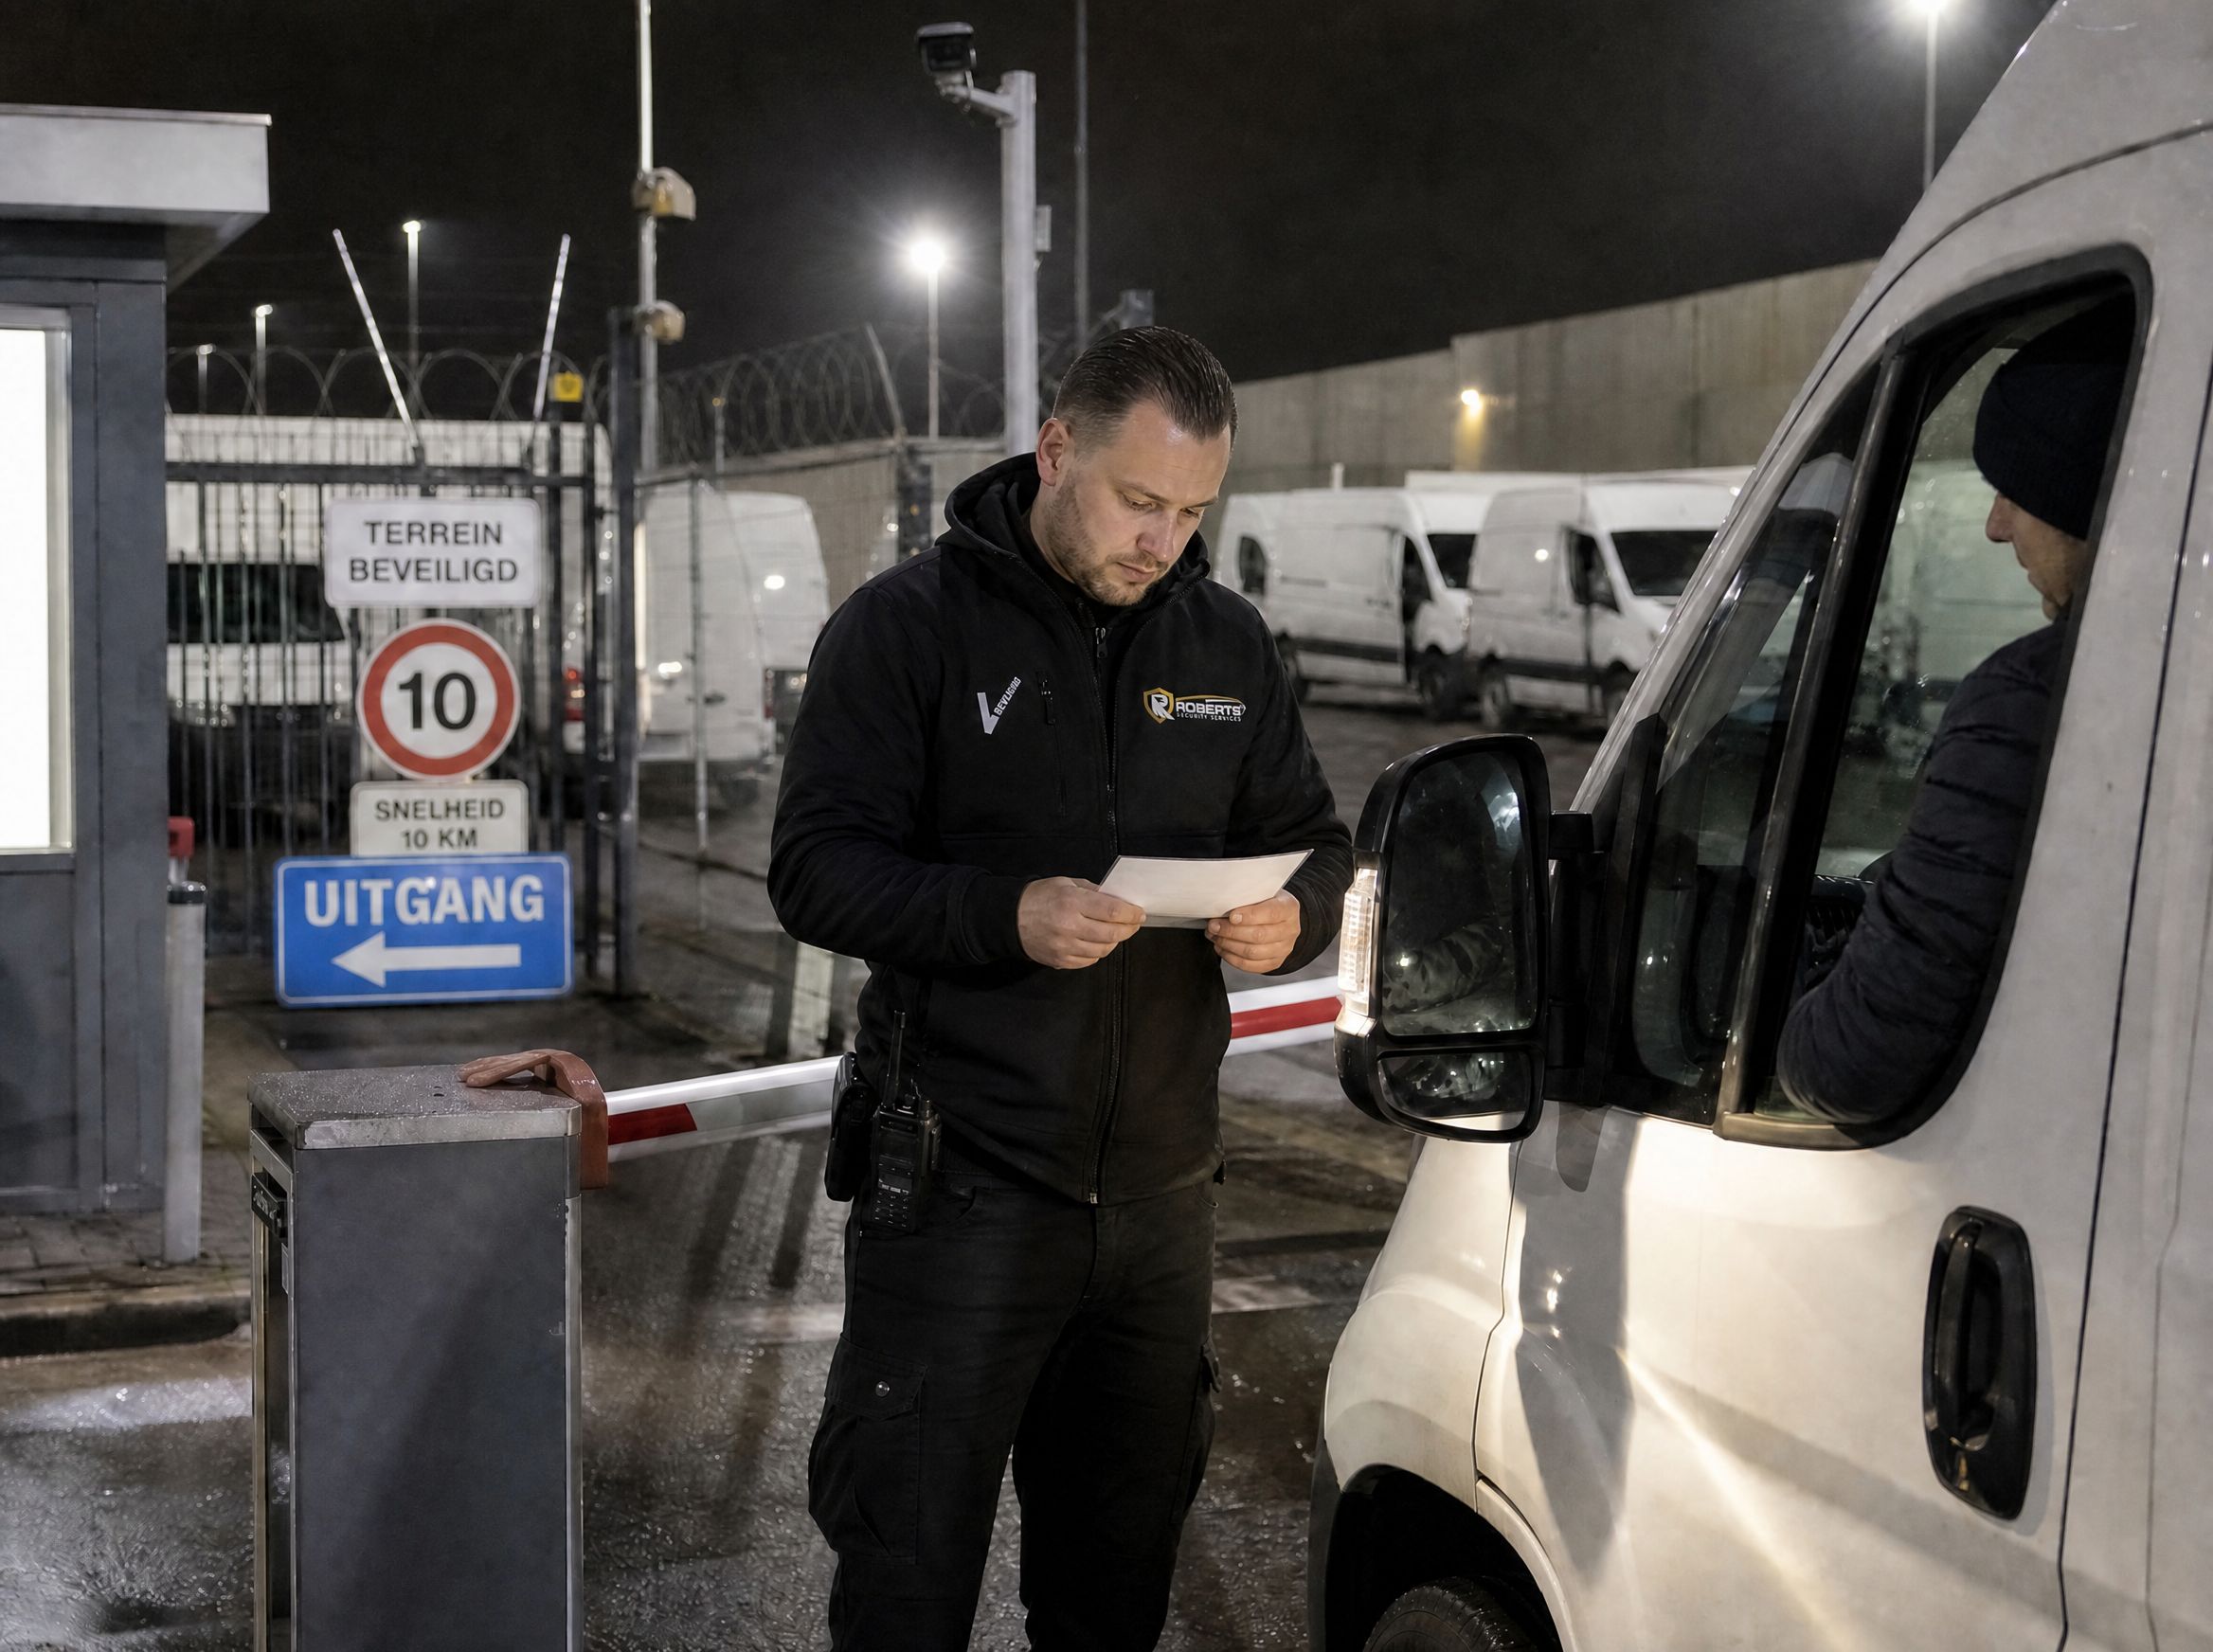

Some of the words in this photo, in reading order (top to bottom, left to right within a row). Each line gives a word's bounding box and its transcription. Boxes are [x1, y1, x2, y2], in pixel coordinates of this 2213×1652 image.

[365, 521, 503, 545] TERREIN
[350, 559, 517, 583] BEVEILIGD
[399, 672, 476, 730] 10
[1176, 702, 1241, 716] ROBERTS
[374, 799, 505, 821] SNELHEID
[402, 828, 428, 849] 10
[439, 828, 477, 849] KM
[304, 875, 545, 926] UITGANG
